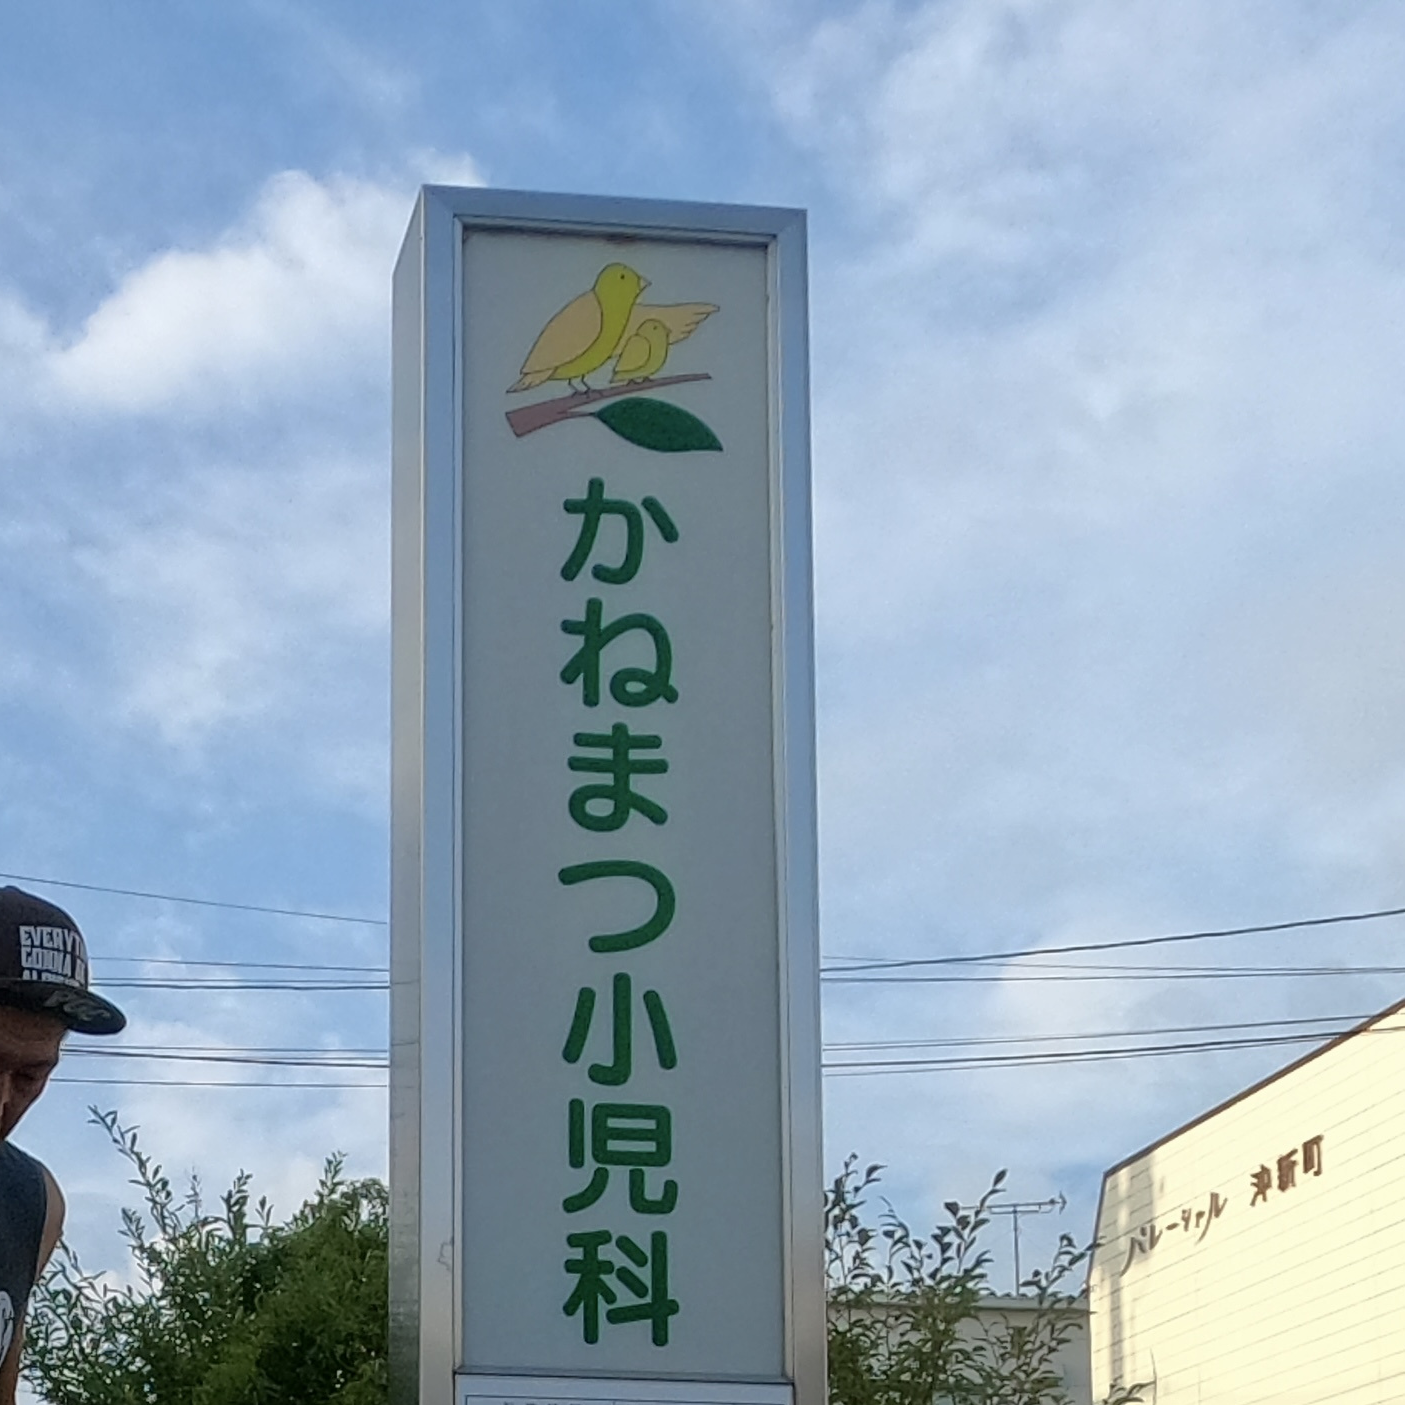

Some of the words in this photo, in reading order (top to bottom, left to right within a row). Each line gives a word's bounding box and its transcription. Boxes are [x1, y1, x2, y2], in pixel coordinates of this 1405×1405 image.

[558, 477, 681, 1347] かねまつ小児科
